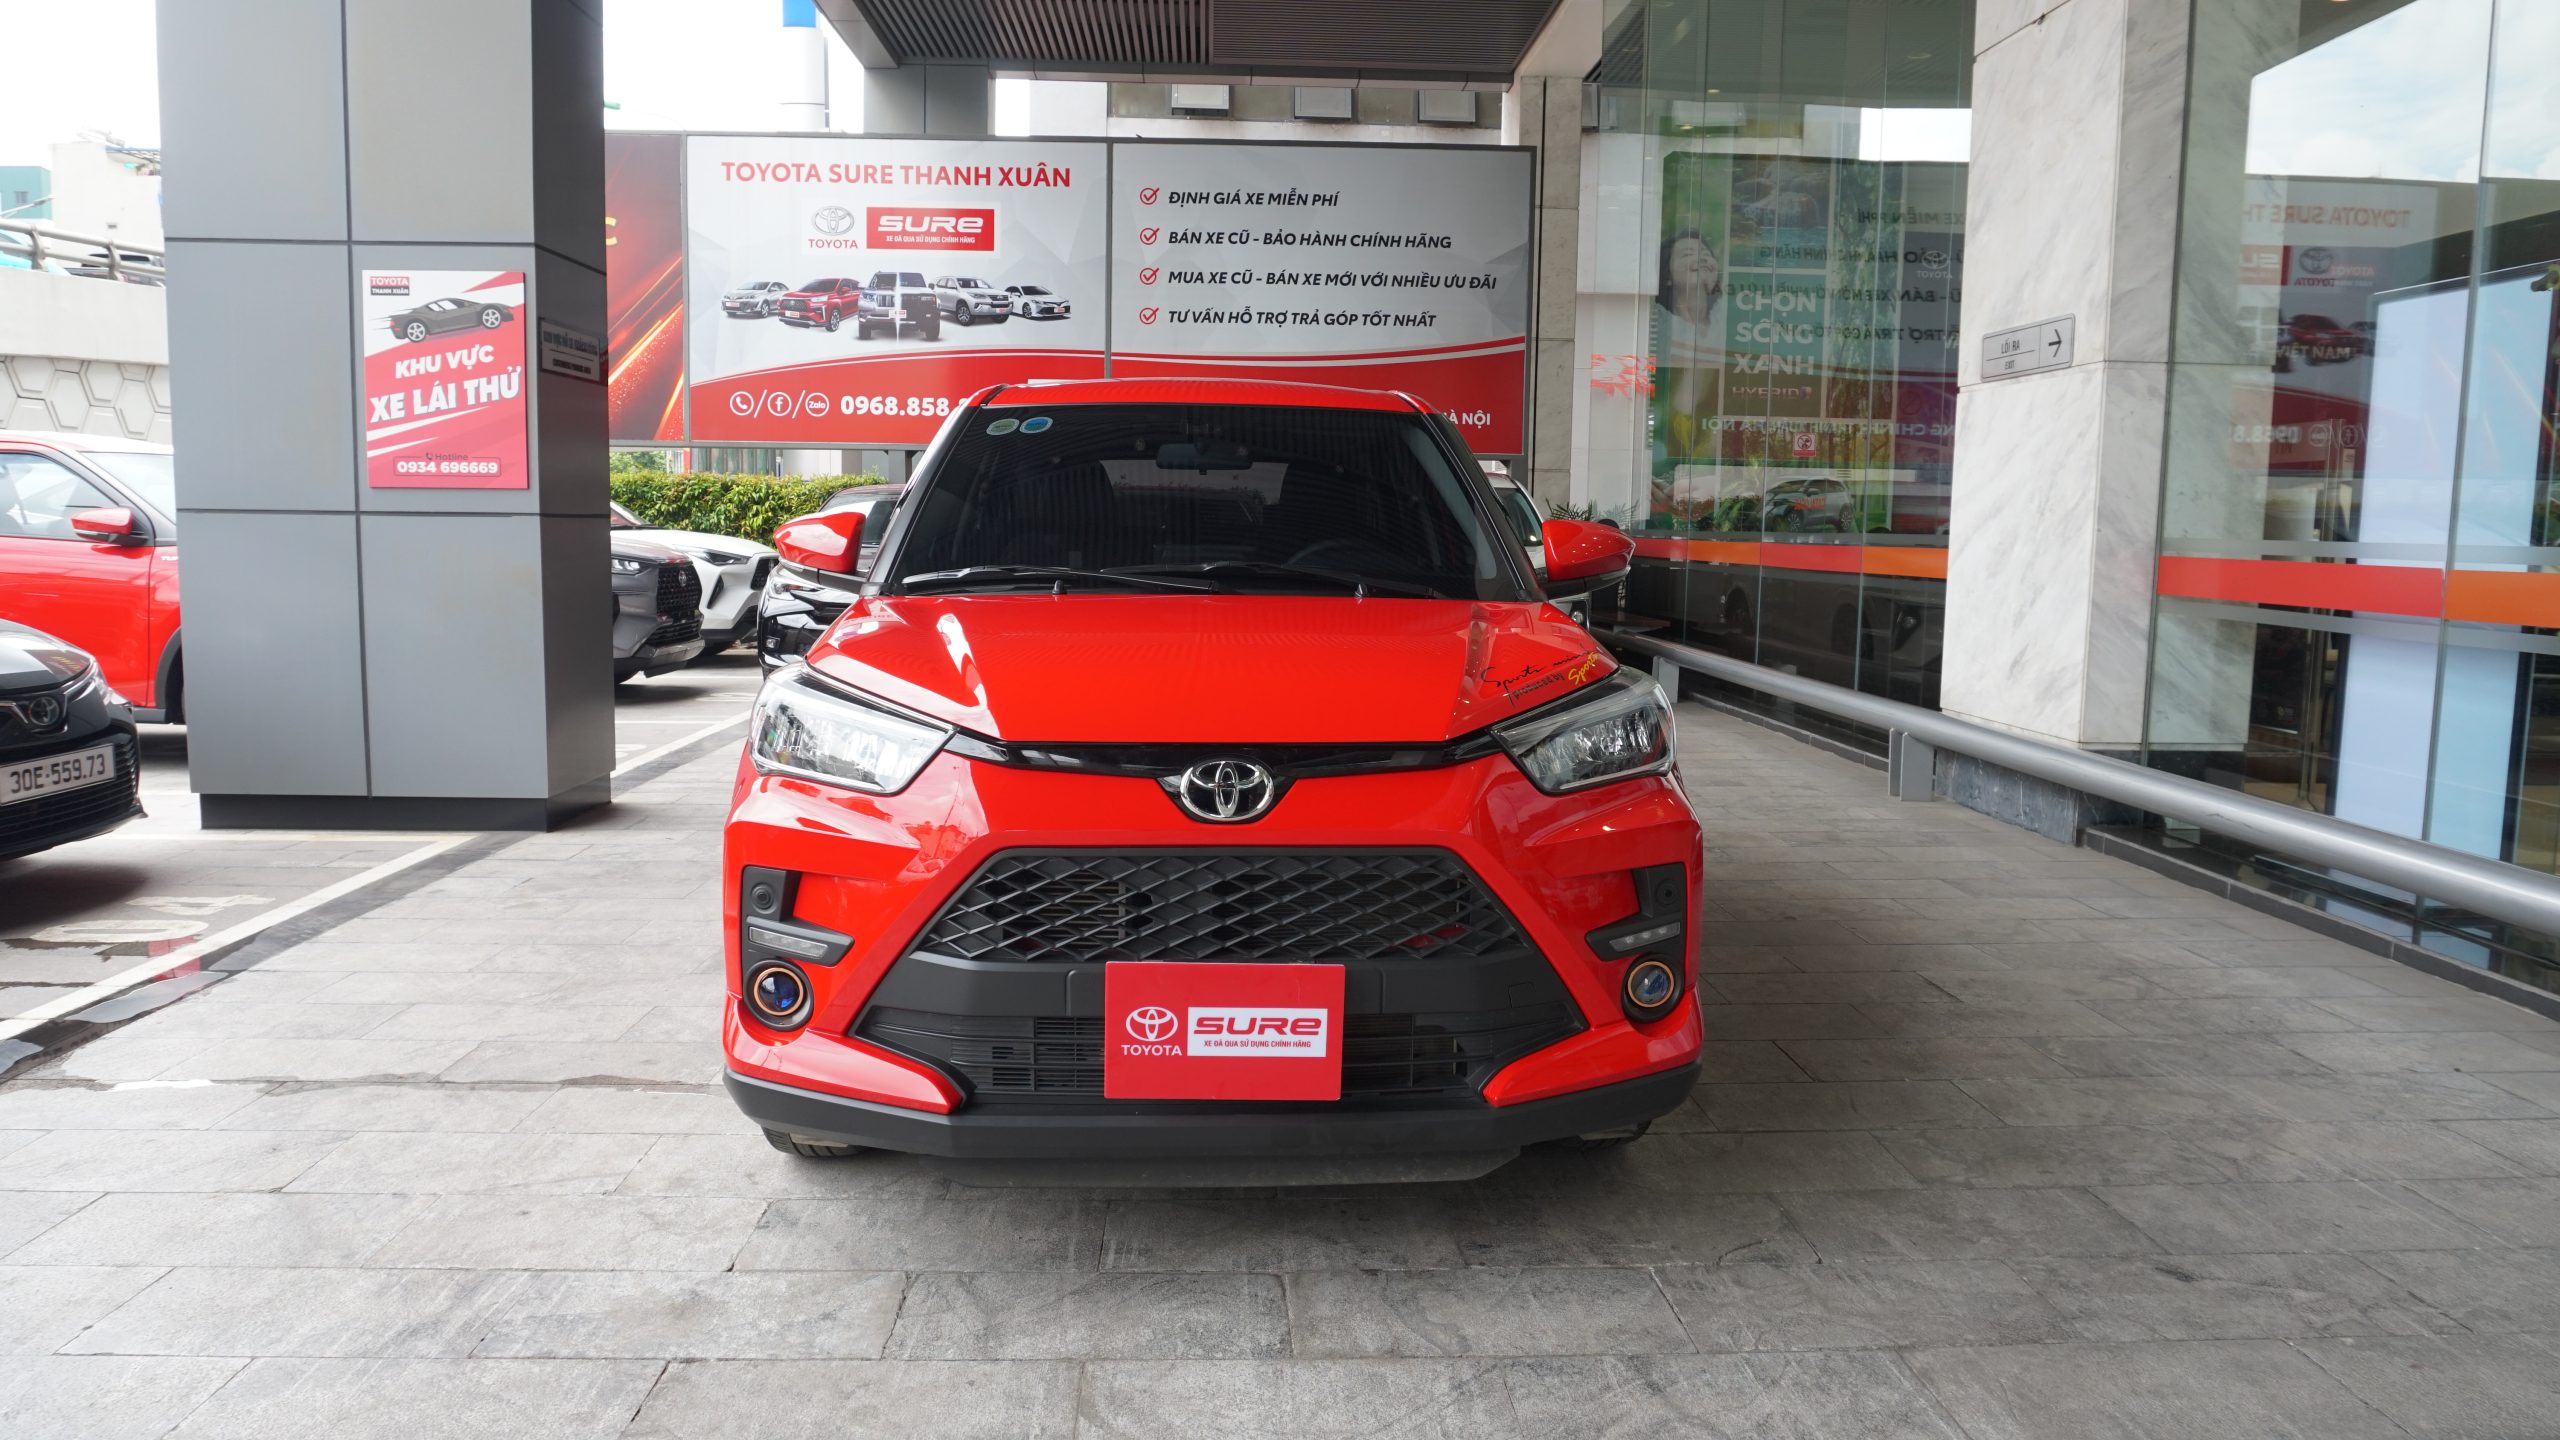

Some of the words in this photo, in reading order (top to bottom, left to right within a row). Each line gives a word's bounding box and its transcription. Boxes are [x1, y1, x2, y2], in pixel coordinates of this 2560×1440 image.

[721, 161, 821, 184] TOYOTA
[829, 163, 893, 185] SURE
[901, 165, 991, 187] THANH
[998, 161, 1071, 188] XUÂN
[1168, 191, 1210, 207] ĐỊNH
[1213, 190, 1242, 206] GIÁ
[1244, 192, 1265, 206] XE
[1267, 187, 1309, 207] MIỄN
[1311, 191, 1339, 207] PHÍ
[808, 238, 859, 250] TOYOTA
[903, 235, 915, 243] QUA
[1168, 230, 1202, 245] BÁN
[1205, 232, 1226, 245] XE
[1227, 229, 1250, 246] CŨ
[1263, 228, 1297, 246] BẢO
[1299, 231, 1348, 247] HÀNH
[1350, 231, 1402, 249] CHÍNH
[1404, 233, 1452, 249] HÃNG
[371, 277, 409, 286] TOYOTA
[1168, 270, 1205, 285] MUA
[1208, 272, 1228, 285] XE
[1230, 269, 1253, 286] CŨ
[1265, 270, 1300, 286] BÁN
[1302, 273, 1322, 286] XE
[1324, 270, 1357, 287] MỚI
[1360, 270, 1389, 288] VỚI
[1391, 269, 1441, 289] NHIỀU
[1443, 274, 1468, 290] ƯU
[1469, 274, 1497, 290] ĐÃI
[1735, 290, 1816, 317] CHỌN
[1168, 309, 1195, 324] TƯ
[1193, 306, 1226, 325] VẤN
[1228, 304, 1253, 325] HỖ
[1256, 310, 1289, 328] TRỢ
[1291, 308, 1321, 326] TRẢ
[1323, 310, 1359, 326] GÓP
[1361, 308, 1392, 327] TỐT
[1393, 310, 1437, 328] NHẤT
[395, 353, 440, 379] KHU
[446, 344, 495, 371] VỰC
[2312, 346, 2350, 360] NAM
[1733, 353, 1814, 375] XANH
[369, 392, 405, 424] XE
[413, 380, 457, 416] LÁI
[463, 365, 522, 406] THỬ
[808, 400, 826, 409] Zalo
[840, 395, 969, 417] 0968.858
[1462, 410, 1491, 429] NỘI
[435, 453, 469, 461] Hotline
[397, 461, 437, 473] 0934
[440, 462, 498, 474] 696669
[10, 753, 106, 794] 30E-559.73
[1121, 1044, 1182, 1056] TOYOTA
[1213, 1039, 1223, 1048] ĐÃ
[1224, 1040, 1239, 1048] QUA
[1240, 1038, 1249, 1048] SỬ
[1250, 1040, 1270, 1049] DỤNG
[1270, 1038, 1291, 1048] CHÍNH
[1292, 1039, 1312, 1048] HÃNG
